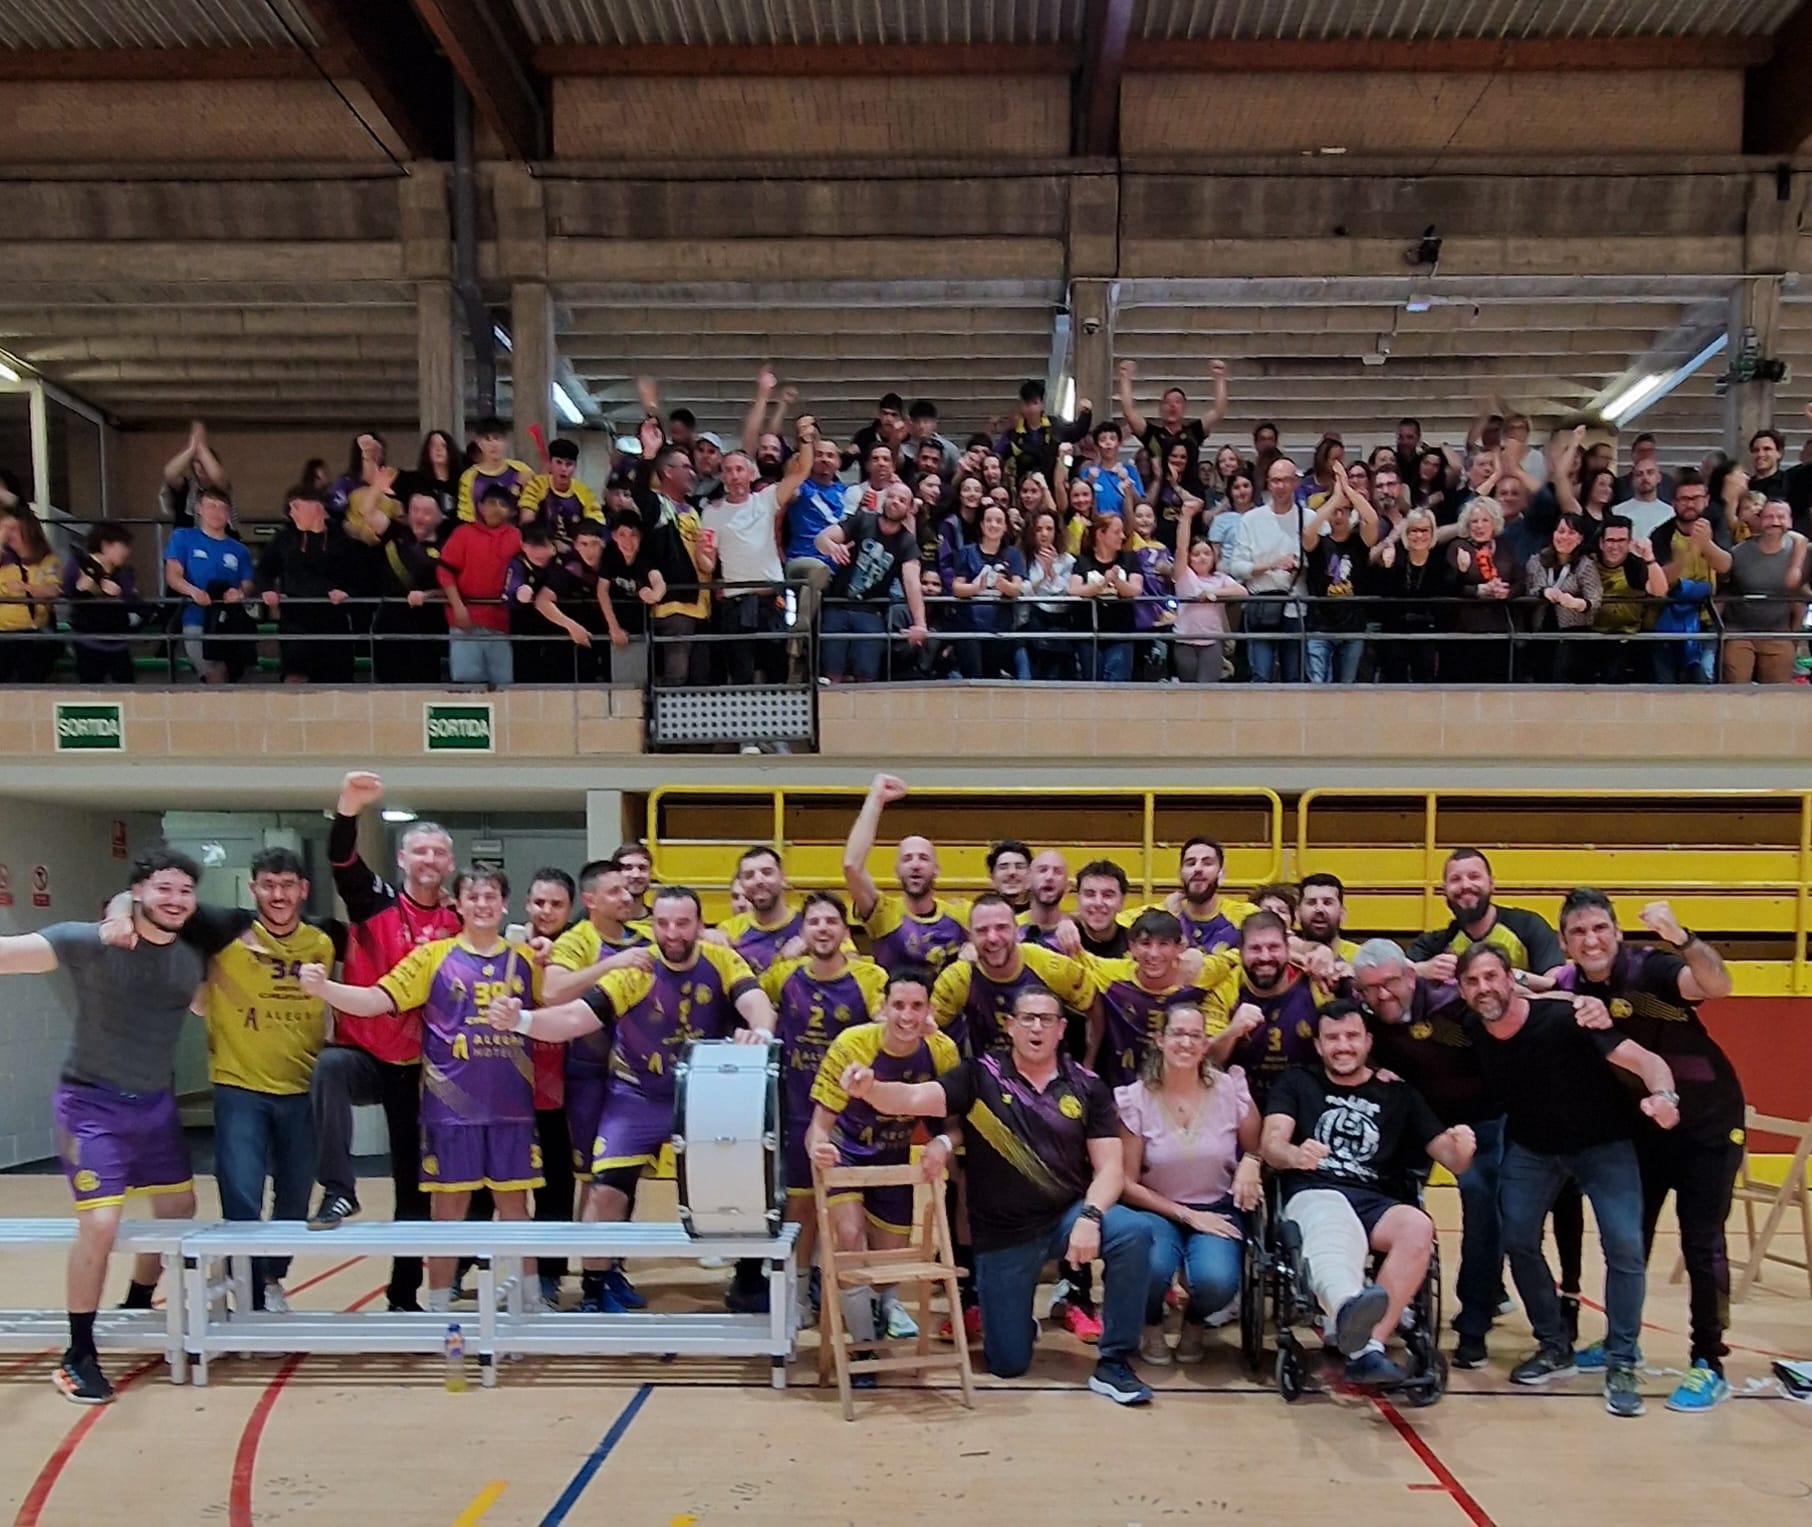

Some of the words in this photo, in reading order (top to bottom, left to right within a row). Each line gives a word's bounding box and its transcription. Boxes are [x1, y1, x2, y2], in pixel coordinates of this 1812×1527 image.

[58, 718, 121, 737] SORTIDA
[428, 718, 489, 737] SORTIDA
[808, 1005, 825, 1028] 2
[1268, 1027, 1282, 1051] 3
